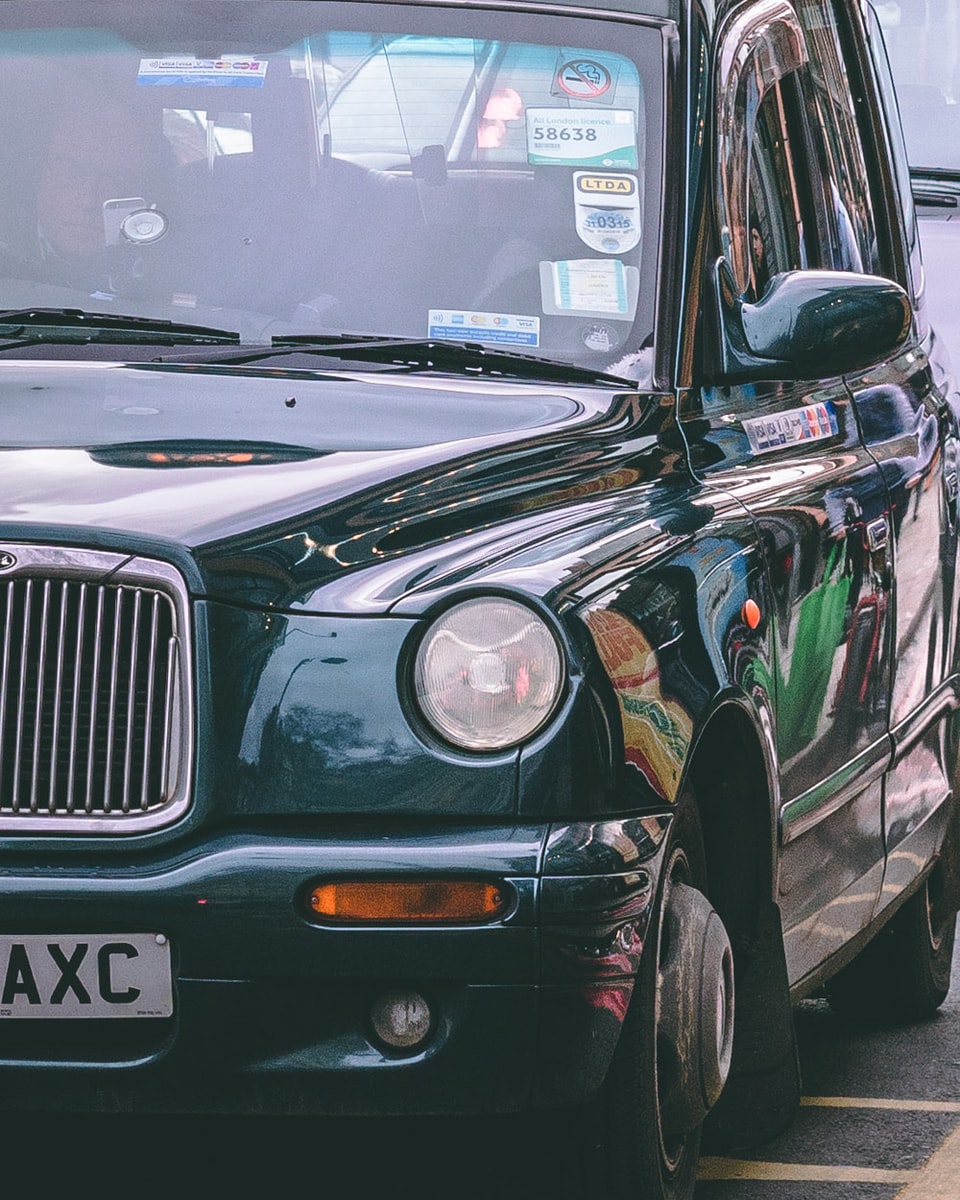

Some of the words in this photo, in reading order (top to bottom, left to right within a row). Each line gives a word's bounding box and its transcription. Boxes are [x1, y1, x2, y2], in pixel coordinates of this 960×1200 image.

[533, 117, 545, 125] All
[546, 117, 578, 125] London
[580, 118, 611, 126] licence
[533, 127, 597, 141] 58638
[585, 179, 628, 191] LTDA
[1, 943, 141, 1005] AXC
